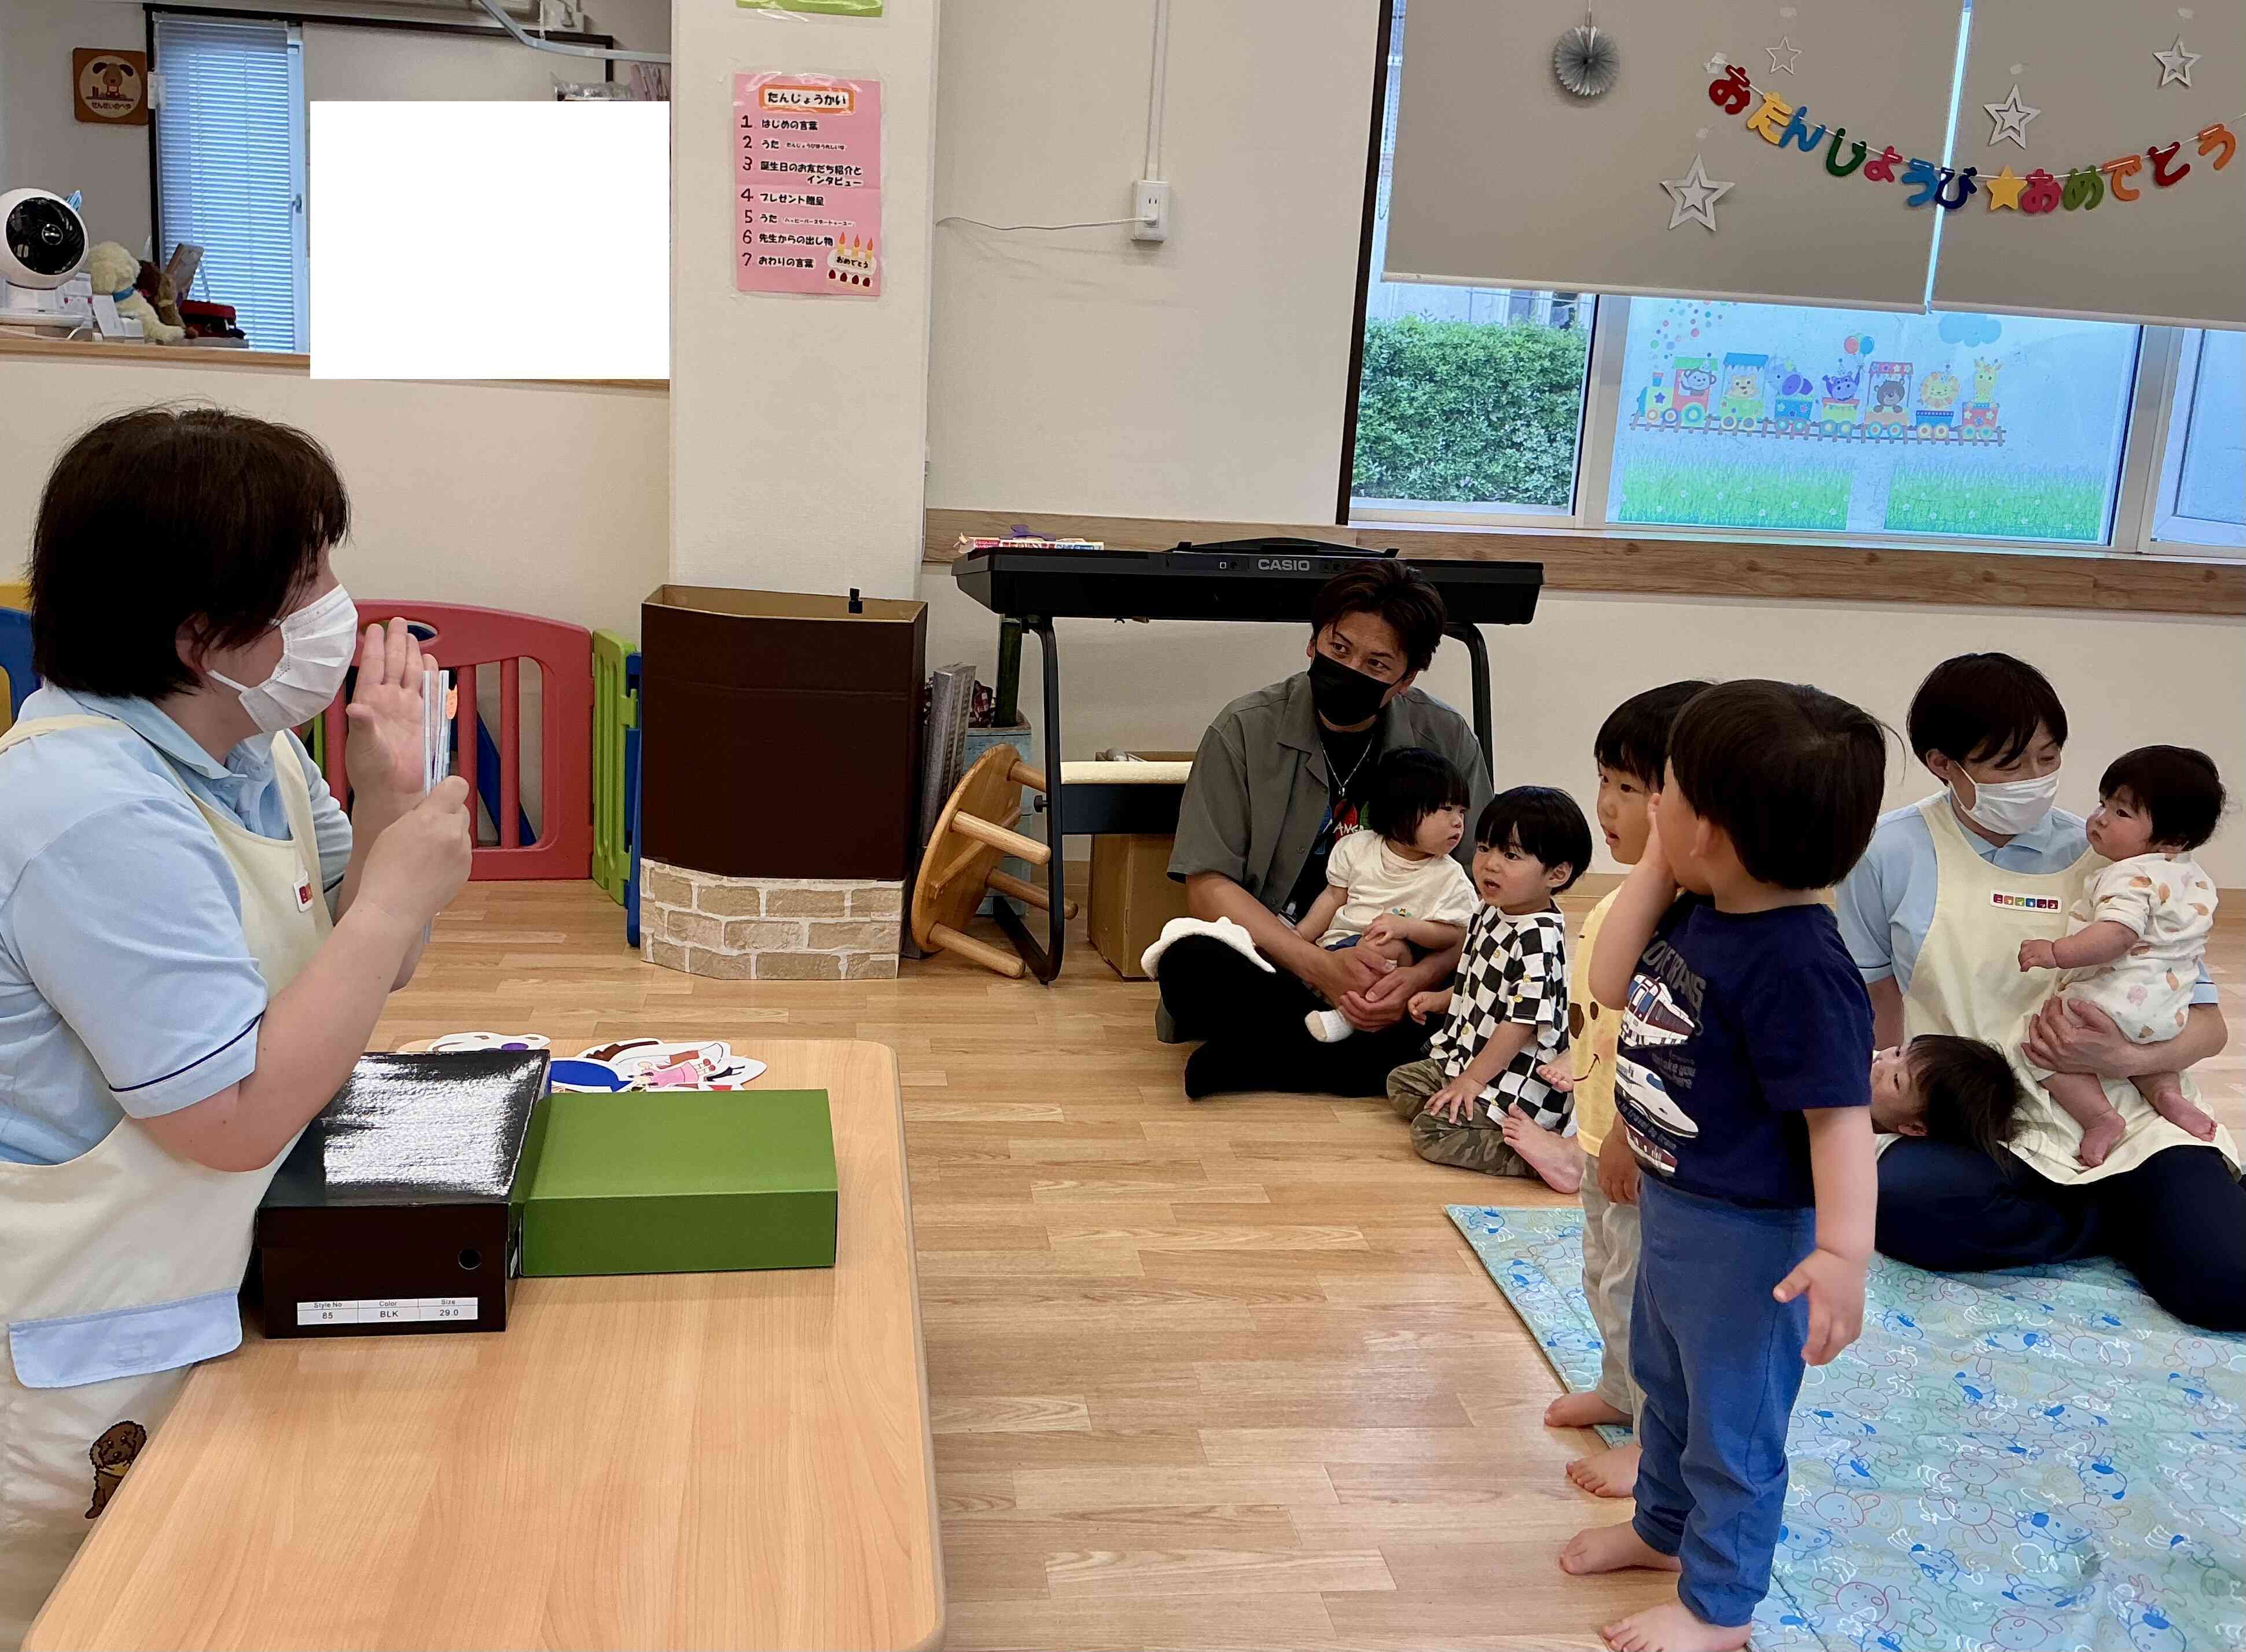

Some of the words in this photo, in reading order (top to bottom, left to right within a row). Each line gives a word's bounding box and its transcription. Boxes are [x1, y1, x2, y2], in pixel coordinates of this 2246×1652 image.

[767, 91, 847, 106] たんじょうかい
[761, 119, 818, 131] はじめの言葉
[761, 139, 779, 149] うた
[760, 161, 862, 175] 誕生日のお友だち紹介と
[807, 175, 862, 186] インタビュー
[760, 214, 778, 223] うた
[759, 233, 833, 246] 先生からの出し物
[758, 256, 814, 268] おわりの言葉
[836, 256, 869, 268] おめでとう
[1258, 559, 1310, 571] CASIO
[322, 1312, 333, 1320] 85
[380, 1310, 399, 1318] BLK
